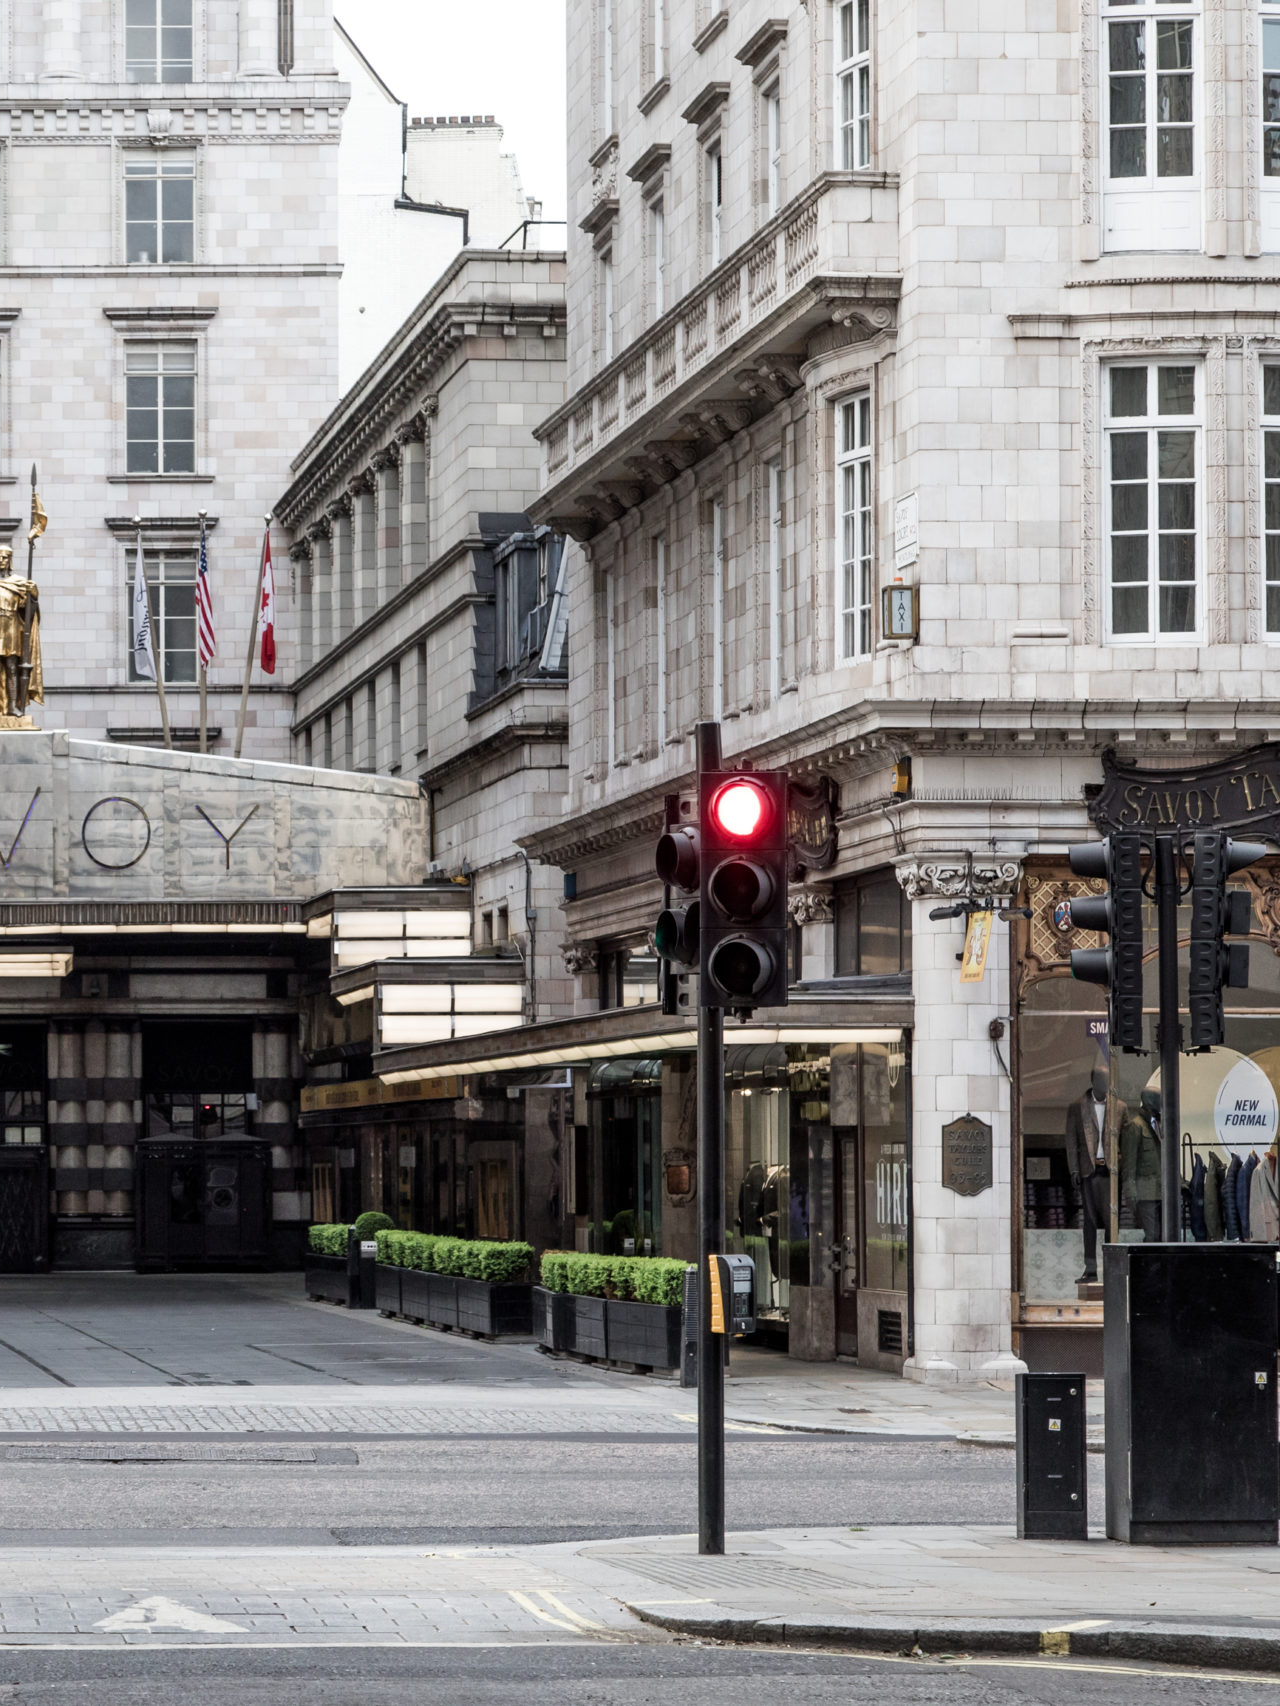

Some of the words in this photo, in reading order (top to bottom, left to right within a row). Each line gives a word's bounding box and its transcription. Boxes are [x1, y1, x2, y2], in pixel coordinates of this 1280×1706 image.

[897, 590, 906, 633] TAXI
[1119, 783, 1224, 826] SAVOY
[1234, 1099, 1260, 1112] NEW
[1224, 1114, 1267, 1127] FORMAL
[948, 1129, 986, 1141] SAVOY
